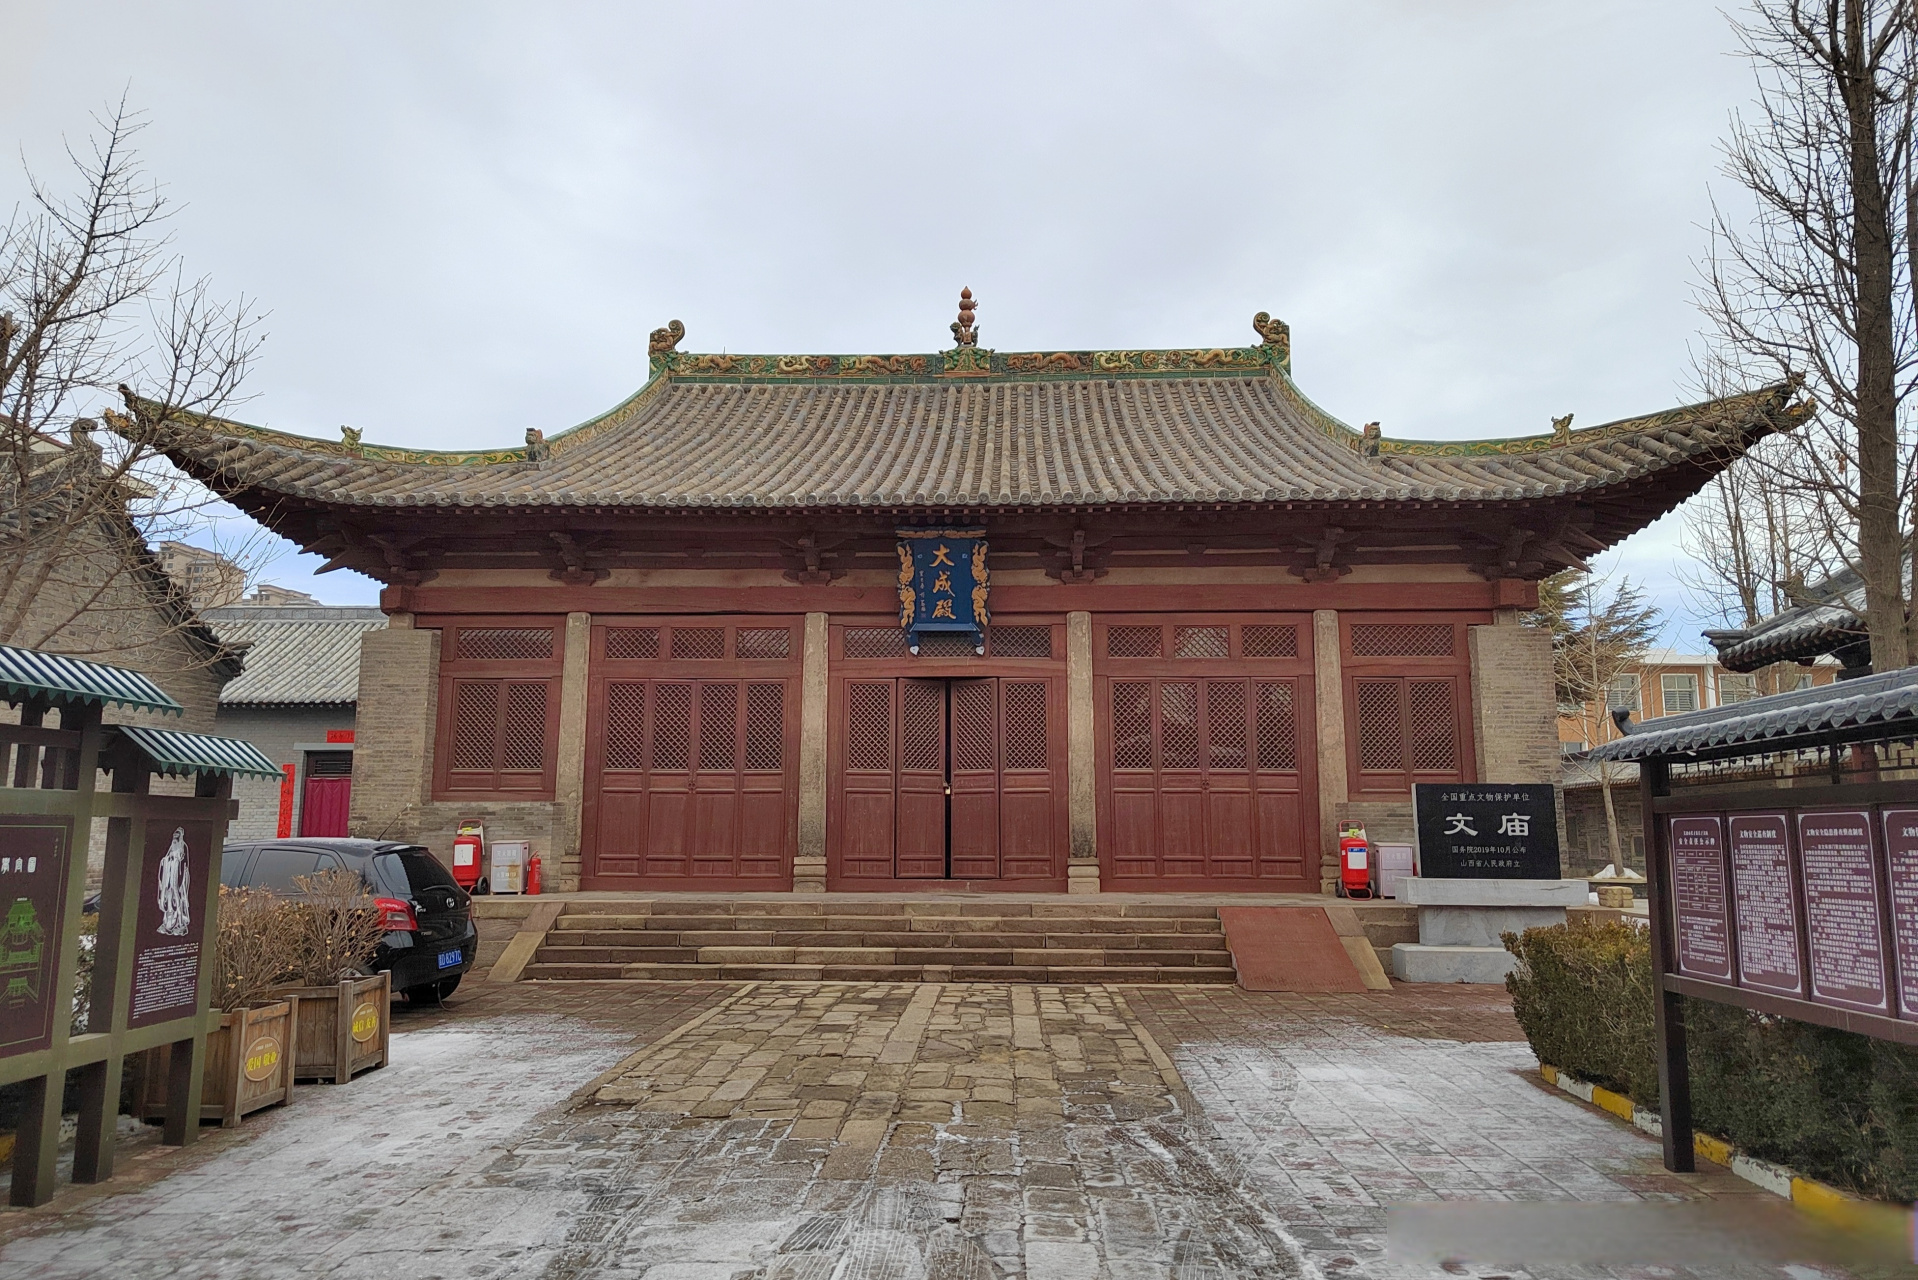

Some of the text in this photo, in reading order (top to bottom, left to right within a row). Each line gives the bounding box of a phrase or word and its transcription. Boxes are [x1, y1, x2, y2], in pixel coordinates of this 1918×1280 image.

[929, 543, 957, 620] 大成殿
[1441, 792, 1530, 802] 全国重点文物保护单位
[1443, 812, 1532, 837] 文庙
[1451, 845, 1527, 854] 国务院2019年10月公布
[1460, 859, 1521, 868] 山西省人民政府立
